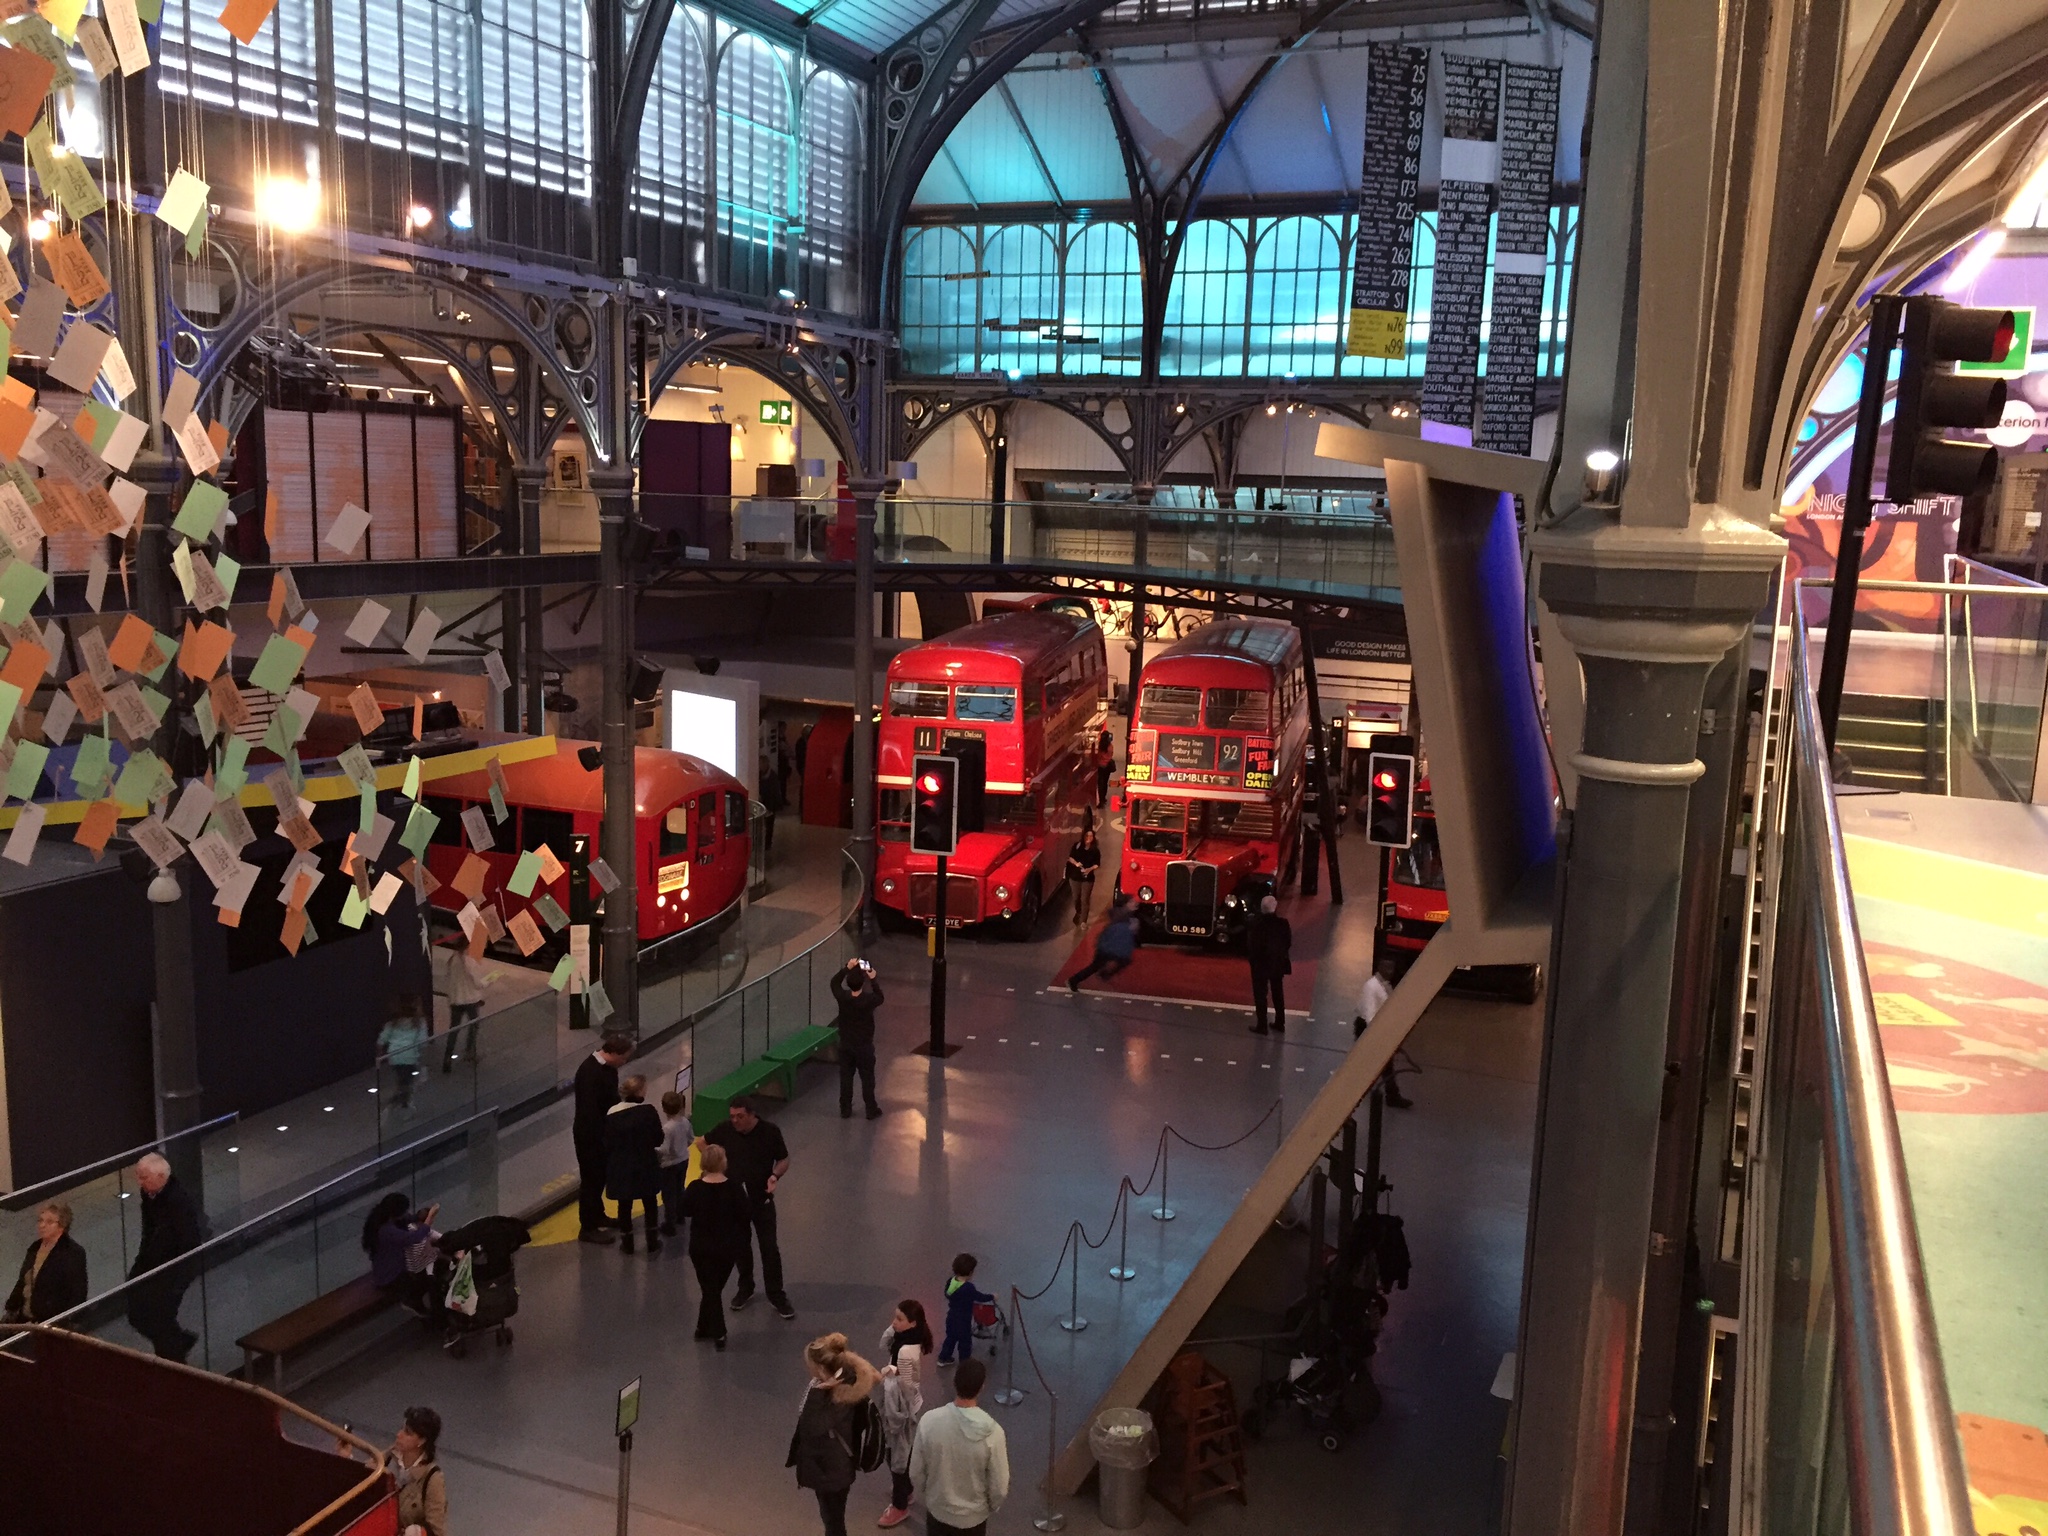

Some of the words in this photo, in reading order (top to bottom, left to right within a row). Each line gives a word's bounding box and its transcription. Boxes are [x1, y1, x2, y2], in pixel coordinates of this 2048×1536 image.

[1446, 54, 1486, 66] SUDBURY
[1412, 64, 1426, 84] 25
[1409, 87, 1424, 107] 56
[1408, 110, 1423, 129] 58
[1536, 121, 1555, 132] ARCH
[1407, 133, 1421, 152] 69
[1404, 156, 1418, 175] 86
[1521, 171, 1541, 182] LANE
[1400, 179, 1417, 198] 173
[1442, 181, 1486, 192] ALPERTON
[1441, 191, 1462, 201] RENT
[1463, 192, 1490, 202] GREEN
[1396, 201, 1415, 221] 225
[1439, 211, 1465, 222] ALING
[1397, 225, 1413, 243] 241
[1391, 246, 1411, 265] 262
[1437, 252, 1474, 263] ARLESDEN
[1435, 262, 1470, 273] ARLESDEN
[1390, 269, 1410, 287] 278
[1518, 276, 1543, 287] GREEN
[1355, 289, 1390, 300] STRATFORD
[1436, 293, 1472, 304] NGSBURY
[1357, 297, 1386, 307] CIRCULAR
[1520, 307, 1541, 316] HALL
[1432, 313, 1446, 323] ARK
[1447, 315, 1467, 324] ROYAL
[1386, 316, 1404, 333] N76
[1431, 323, 1443, 333] ARK
[1467, 326, 1480, 335] STN
[1490, 324, 1506, 334] EAST
[1507, 326, 1528, 335] ACTON
[1433, 334, 1471, 345] PERIVALE
[1384, 338, 1403, 355] N99
[1488, 344, 1518, 354] FOREST
[1519, 346, 1536, 356] HILL
[1485, 374, 1514, 384] MARBLE
[1515, 376, 1536, 385] ARCH
[1484, 393, 1522, 403] MITCHAM
[1482, 422, 1508, 432] OXFORD
[1499, 443, 1519, 453] ROYAL
[1806, 514, 1836, 522] LONDON
[1335, 640, 1356, 649] GOOD
[1357, 641, 1382, 651] DESIGN
[1383, 643, 1406, 652] MAKES
[1326, 647, 1340, 655] LIFE
[1350, 649, 1379, 657] LONDON
[1380, 651, 1406, 659] BETTER
[1333, 719, 1343, 728] 12
[919, 731, 931, 747] 11
[1171, 737, 1191, 749] Sudbury
[1247, 738, 1274, 752] BATTERS
[1171, 747, 1191, 759] Sudbury
[1223, 744, 1238, 763] 92
[1248, 751, 1269, 765] FUN
[1174, 755, 1199, 767] Greenford
[1167, 771, 1216, 787] WEMBLEY
[1246, 772, 1273, 783] OPEN
[1245, 781, 1273, 792] DAILY
[689, 799, 696, 809] D
[575, 840, 584, 853] 7
[945, 918, 960, 927] DYE
[1172, 925, 1188, 933] OLD
[1190, 926, 1206, 935] 589
